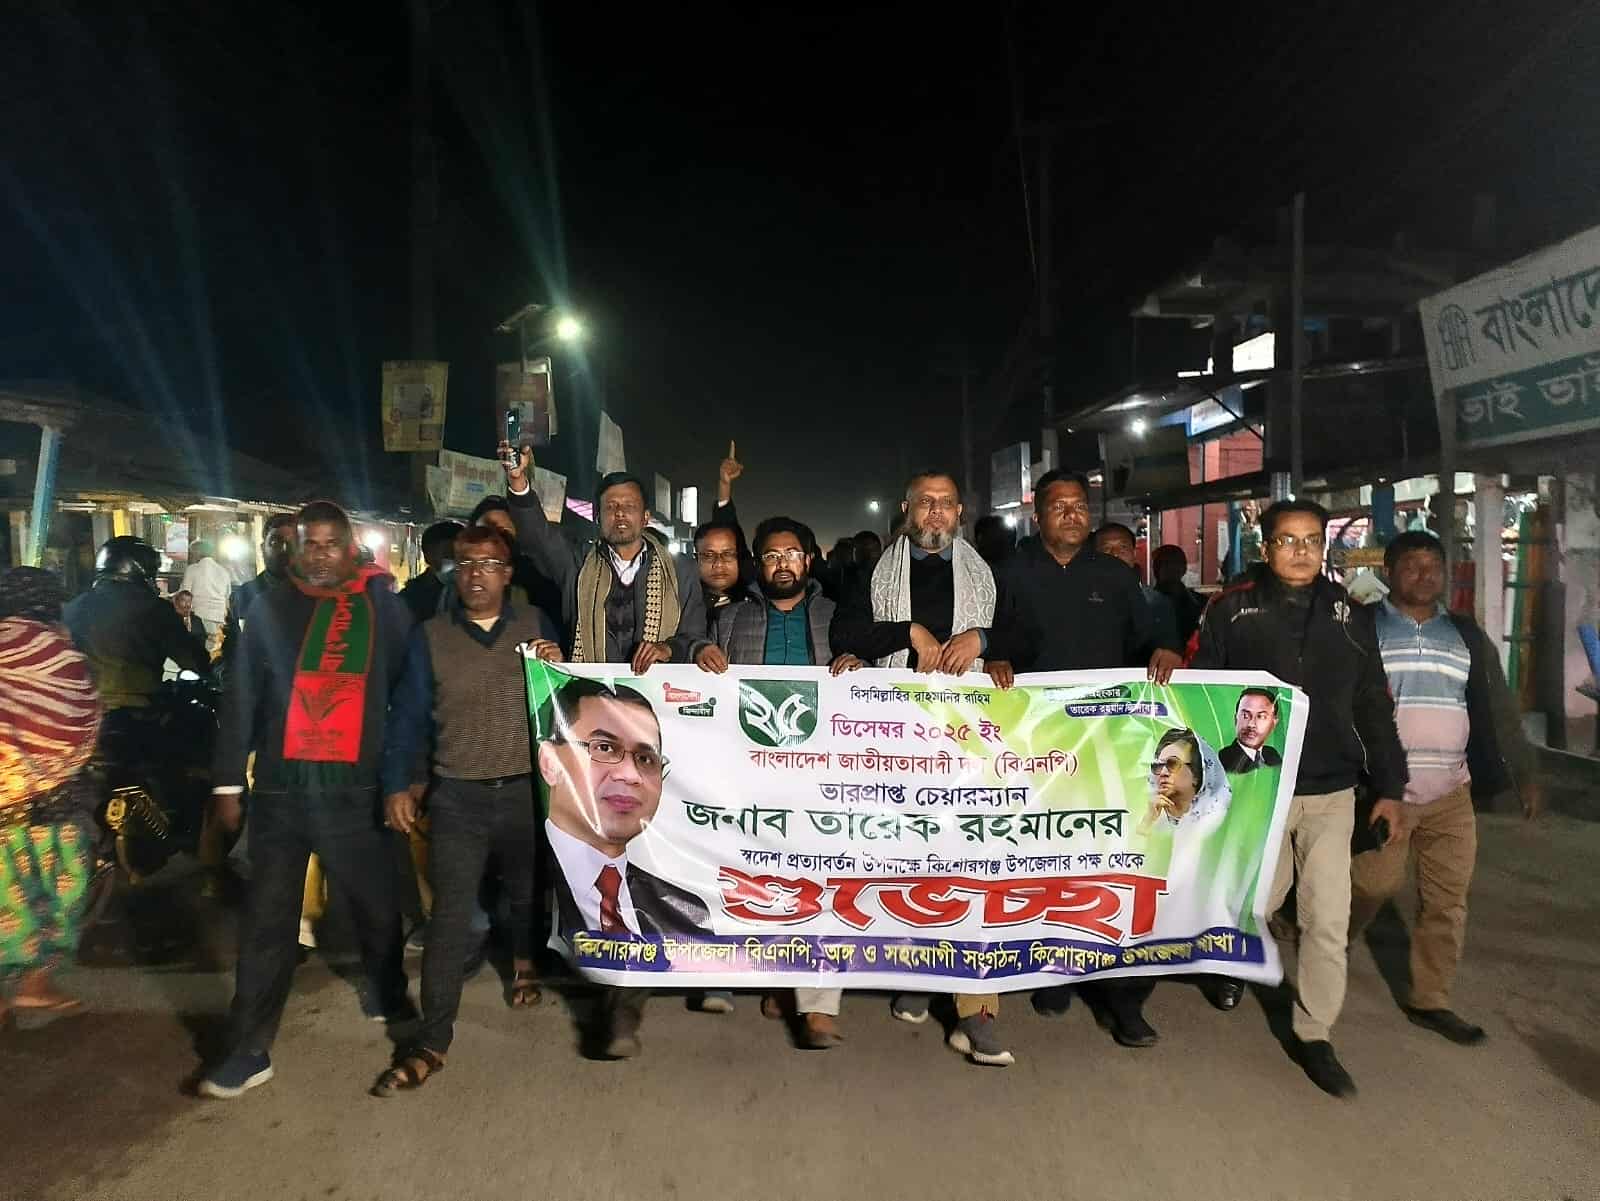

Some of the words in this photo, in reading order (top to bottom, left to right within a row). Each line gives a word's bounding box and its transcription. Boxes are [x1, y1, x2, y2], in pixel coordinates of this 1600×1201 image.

[830, 713, 906, 740] ডিসেম্বর
[913, 721, 971, 743] ২০২৫
[978, 717, 1002, 743] ইং
[748, 749, 832, 770] বাংলাদেশ
[837, 748, 952, 775] জাতীয়তাবাদী
[994, 750, 1077, 779] (বিএনপি)
[818, 782, 907, 805] ভারপ্রাপ্ত
[915, 785, 1029, 806] চেয়ারম্যান
[682, 800, 794, 838] জনাব
[804, 806, 941, 842] তারেক
[740, 848, 782, 869] স্বদেশ
[787, 850, 855, 873] প্রত্যাবর্তন
[926, 854, 1001, 875] কিশোরগঞ্জ
[1005, 853, 1073, 873] উপজেলার
[1078, 853, 1103, 870] পক্ষ
[1108, 852, 1146, 870] থেকে
[718, 866, 1169, 942] শুভেচ্ছা
[662, 936, 738, 964] উপজেলা
[744, 937, 817, 968] বিএনপি,
[863, 946, 876, 962] ও
[884, 940, 956, 970] সহযোগী
[963, 941, 1021, 971] সংগঠন,
